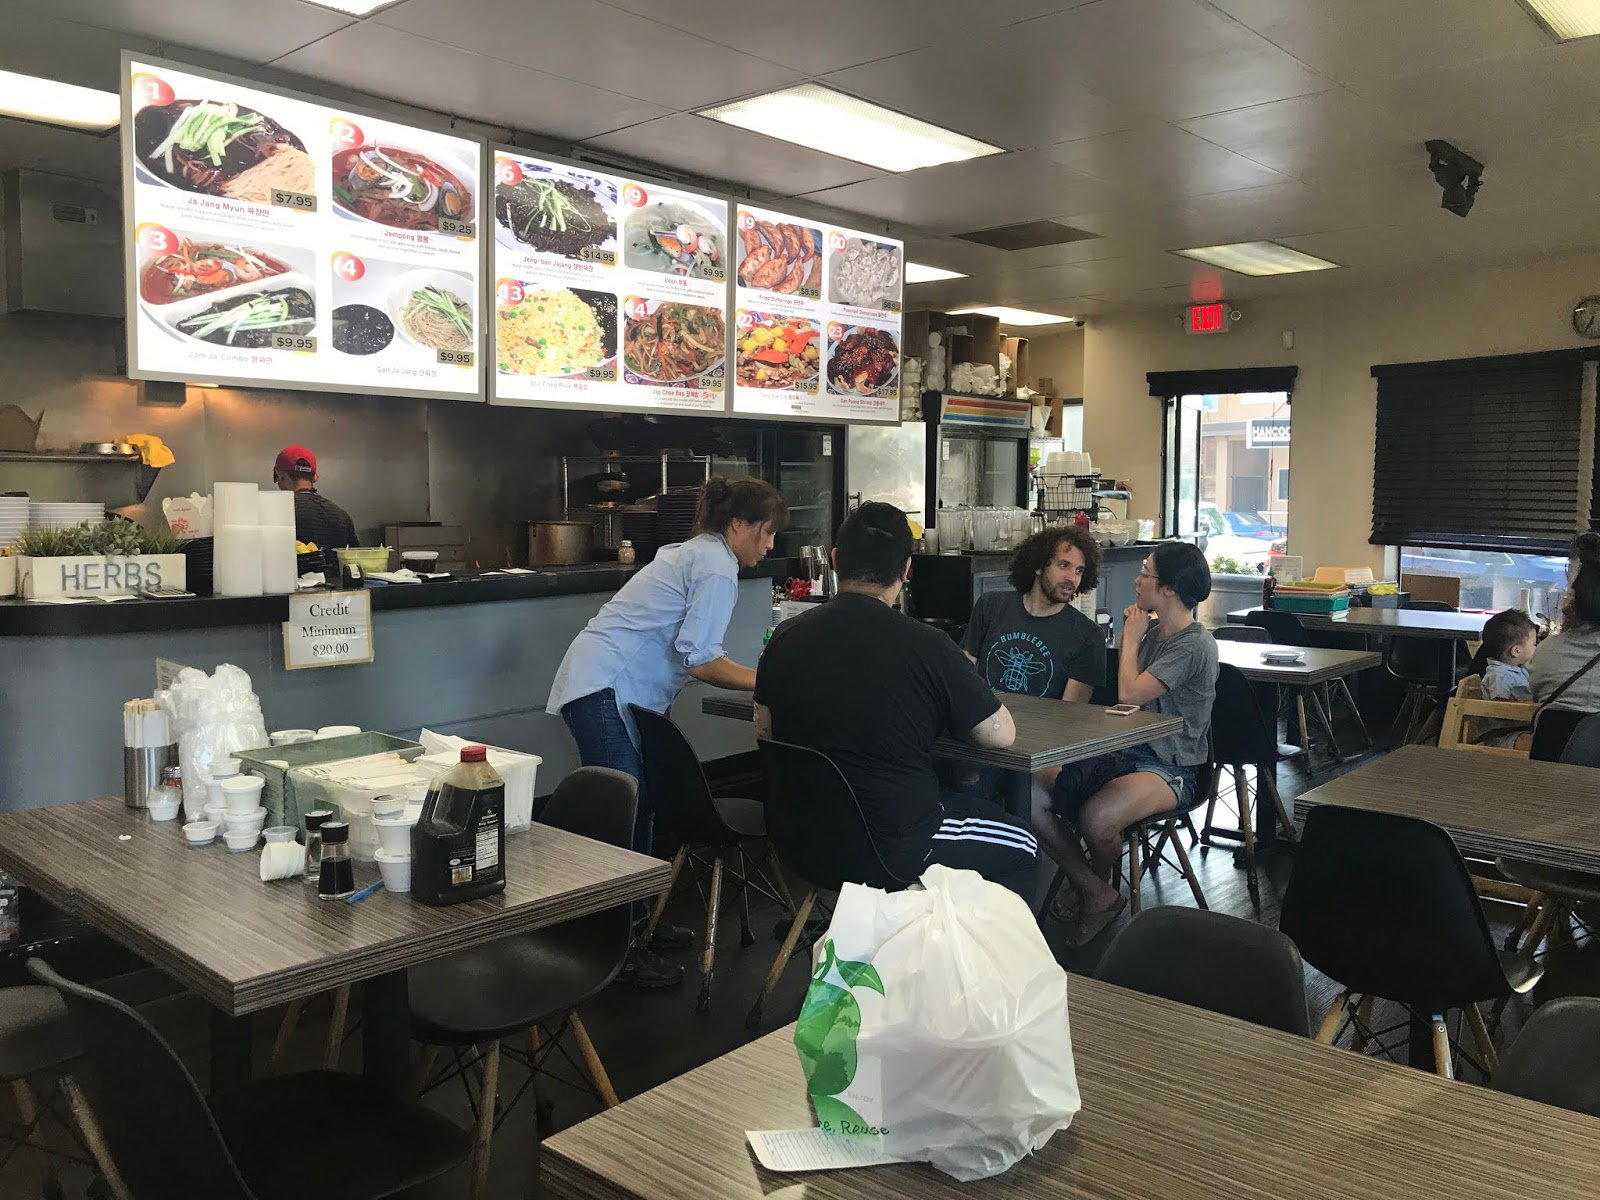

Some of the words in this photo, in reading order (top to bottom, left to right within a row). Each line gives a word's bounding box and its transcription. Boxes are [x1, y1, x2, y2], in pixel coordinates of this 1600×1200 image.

[187, 197, 198, 206] Ja
[199, 199, 221, 210] Jang
[222, 203, 245, 214] Myun
[275, 192, 313, 208] $7.95
[442, 221, 473, 235] $9.25
[151, 231, 168, 250] 3
[583, 250, 615, 263] $14.95
[342, 259, 357, 276] 4
[703, 267, 724, 279] $9.95
[501, 284, 522, 301] 13
[801, 287, 819, 297] $8.95
[1191, 304, 1223, 331] EXIT
[276, 336, 313, 350] $9.95
[440, 351, 471, 365] $9.95
[589, 368, 615, 379] $9.95
[701, 378, 722, 388] $9.95
[794, 381, 817, 390] $15.95
[877, 388, 897, 397] $17.95
[61, 562, 162, 592] HERBS
[309, 602, 350, 617] Credit
[301, 624, 357, 638] Minimum
[312, 642, 349, 657] $20.00
[1000, 631, 1050, 657] BUMBLEBEE
[840, 1120, 890, 1136] Reuse
